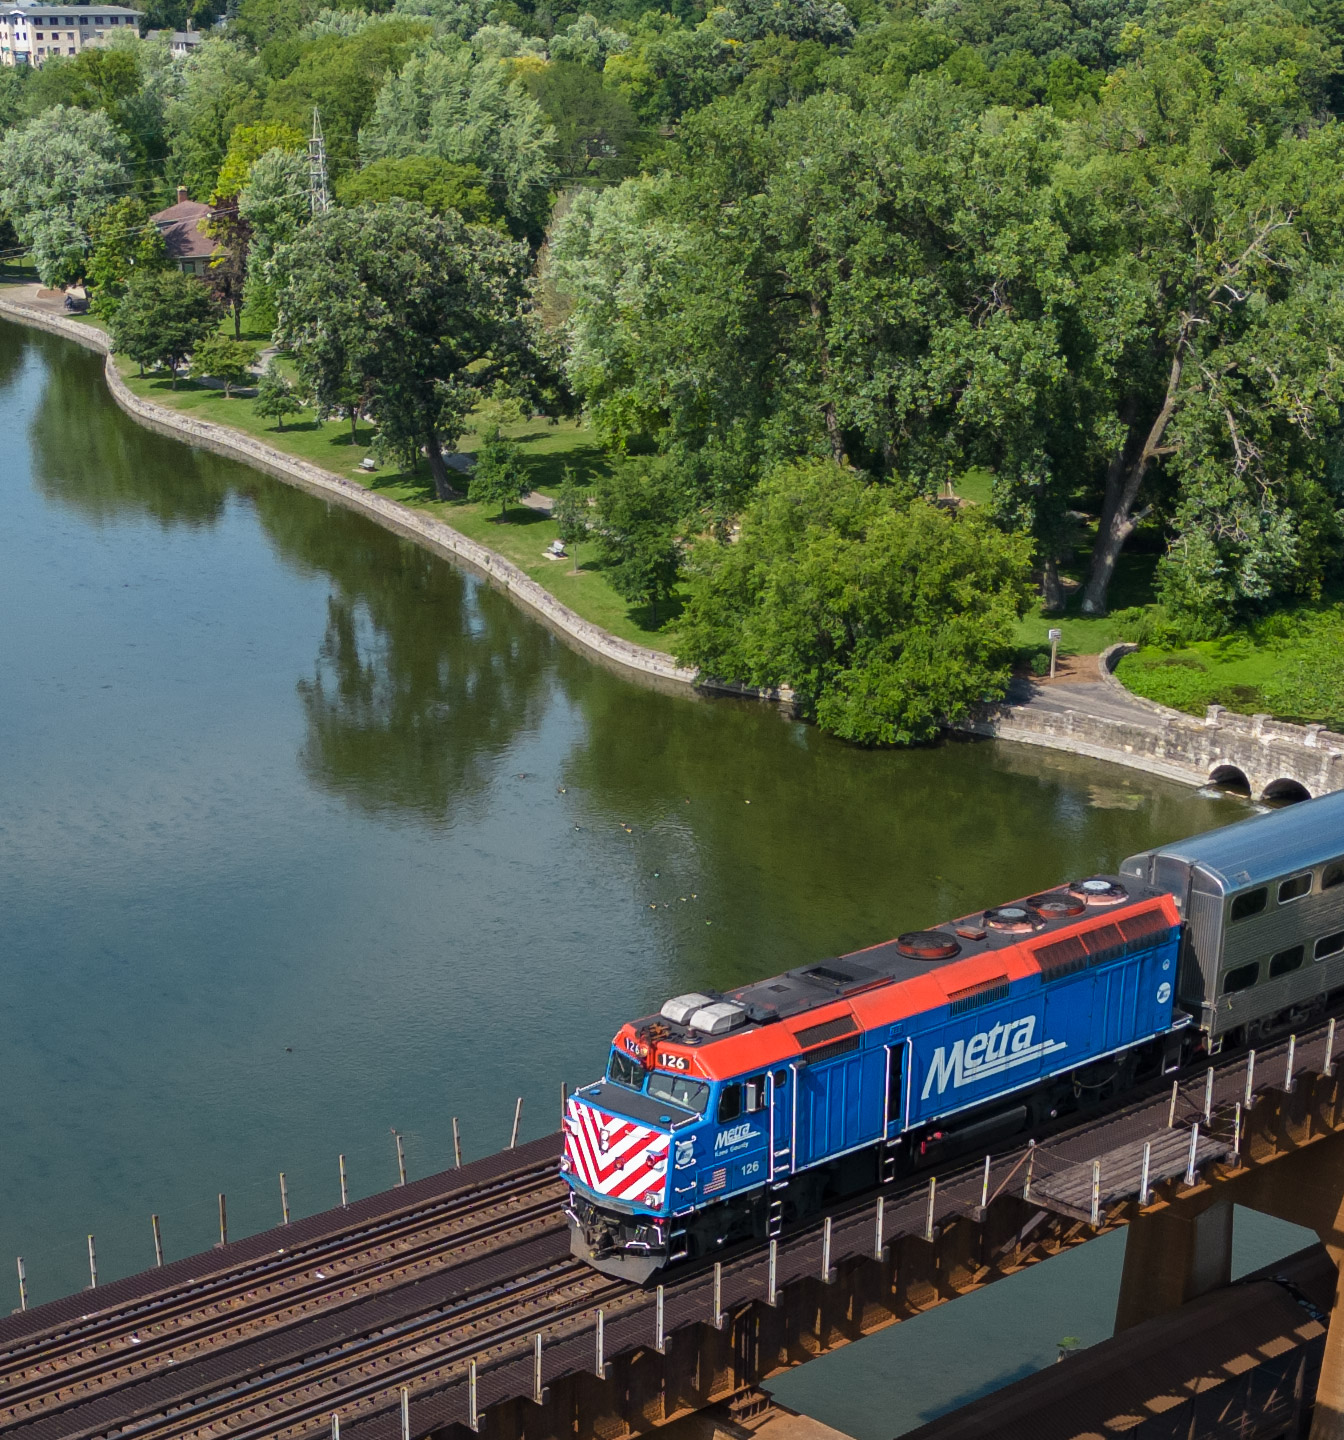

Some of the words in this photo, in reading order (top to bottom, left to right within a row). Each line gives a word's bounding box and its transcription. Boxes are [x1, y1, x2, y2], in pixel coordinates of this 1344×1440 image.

[625, 1038, 640, 1055] 126
[662, 1053, 685, 1070] 126
[921, 1015, 1067, 1100] Metra
[714, 1123, 760, 1150] Metra
[742, 1161, 759, 1176] 126
